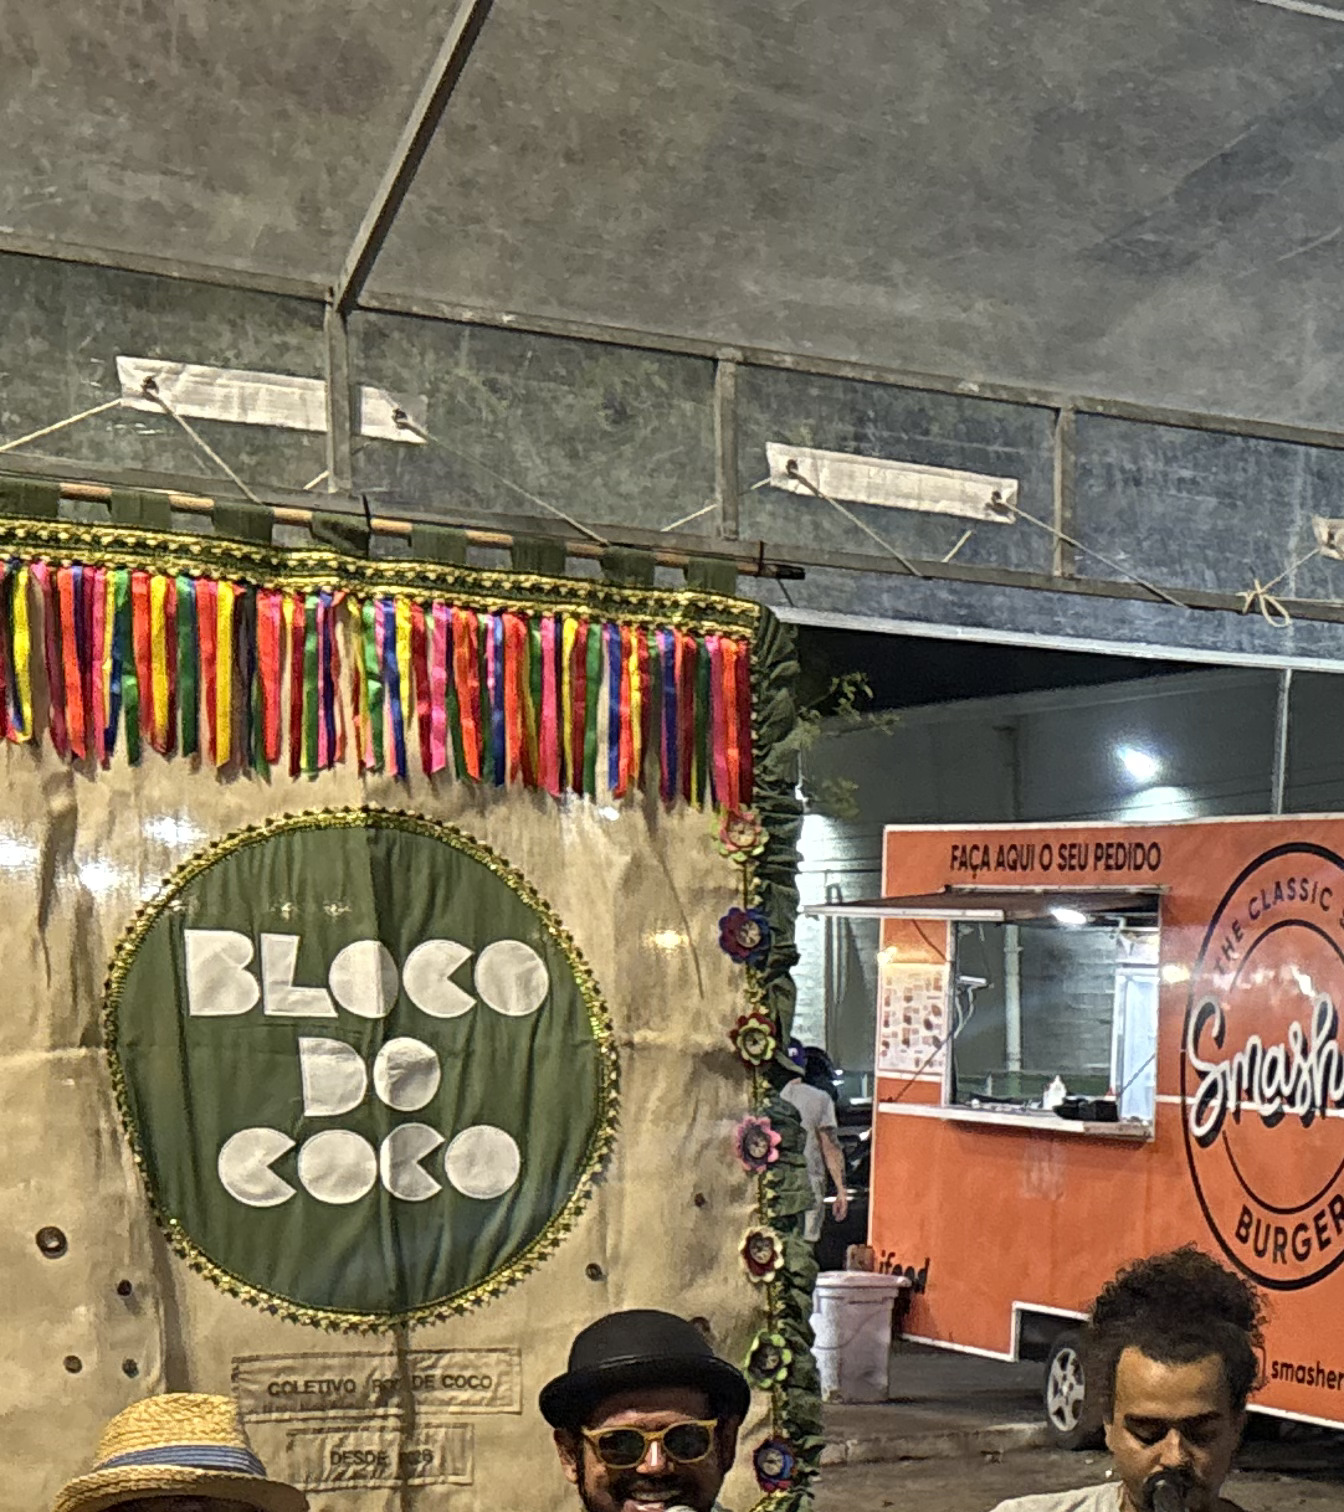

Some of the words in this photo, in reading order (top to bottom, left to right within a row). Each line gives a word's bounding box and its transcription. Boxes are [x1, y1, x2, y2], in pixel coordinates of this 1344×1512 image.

[950, 844, 990, 879] FAÇA
[994, 844, 1035, 873] AQUI
[1039, 844, 1053, 871] O
[1058, 843, 1089, 872] SEU
[1093, 841, 1162, 872] PEDIDO
[1212, 918, 1244, 974] THE
[1247, 876, 1334, 921] CLASSIC
[184, 929, 550, 1019] BLOCO
[298, 1036, 441, 1117] DO
[218, 1121, 521, 1208] COCO
[267, 1378, 357, 1397] COLETIVO
[412, 1374, 436, 1391] DE
[440, 1373, 493, 1390] COCO
[330, 1449, 387, 1467] DESDE
